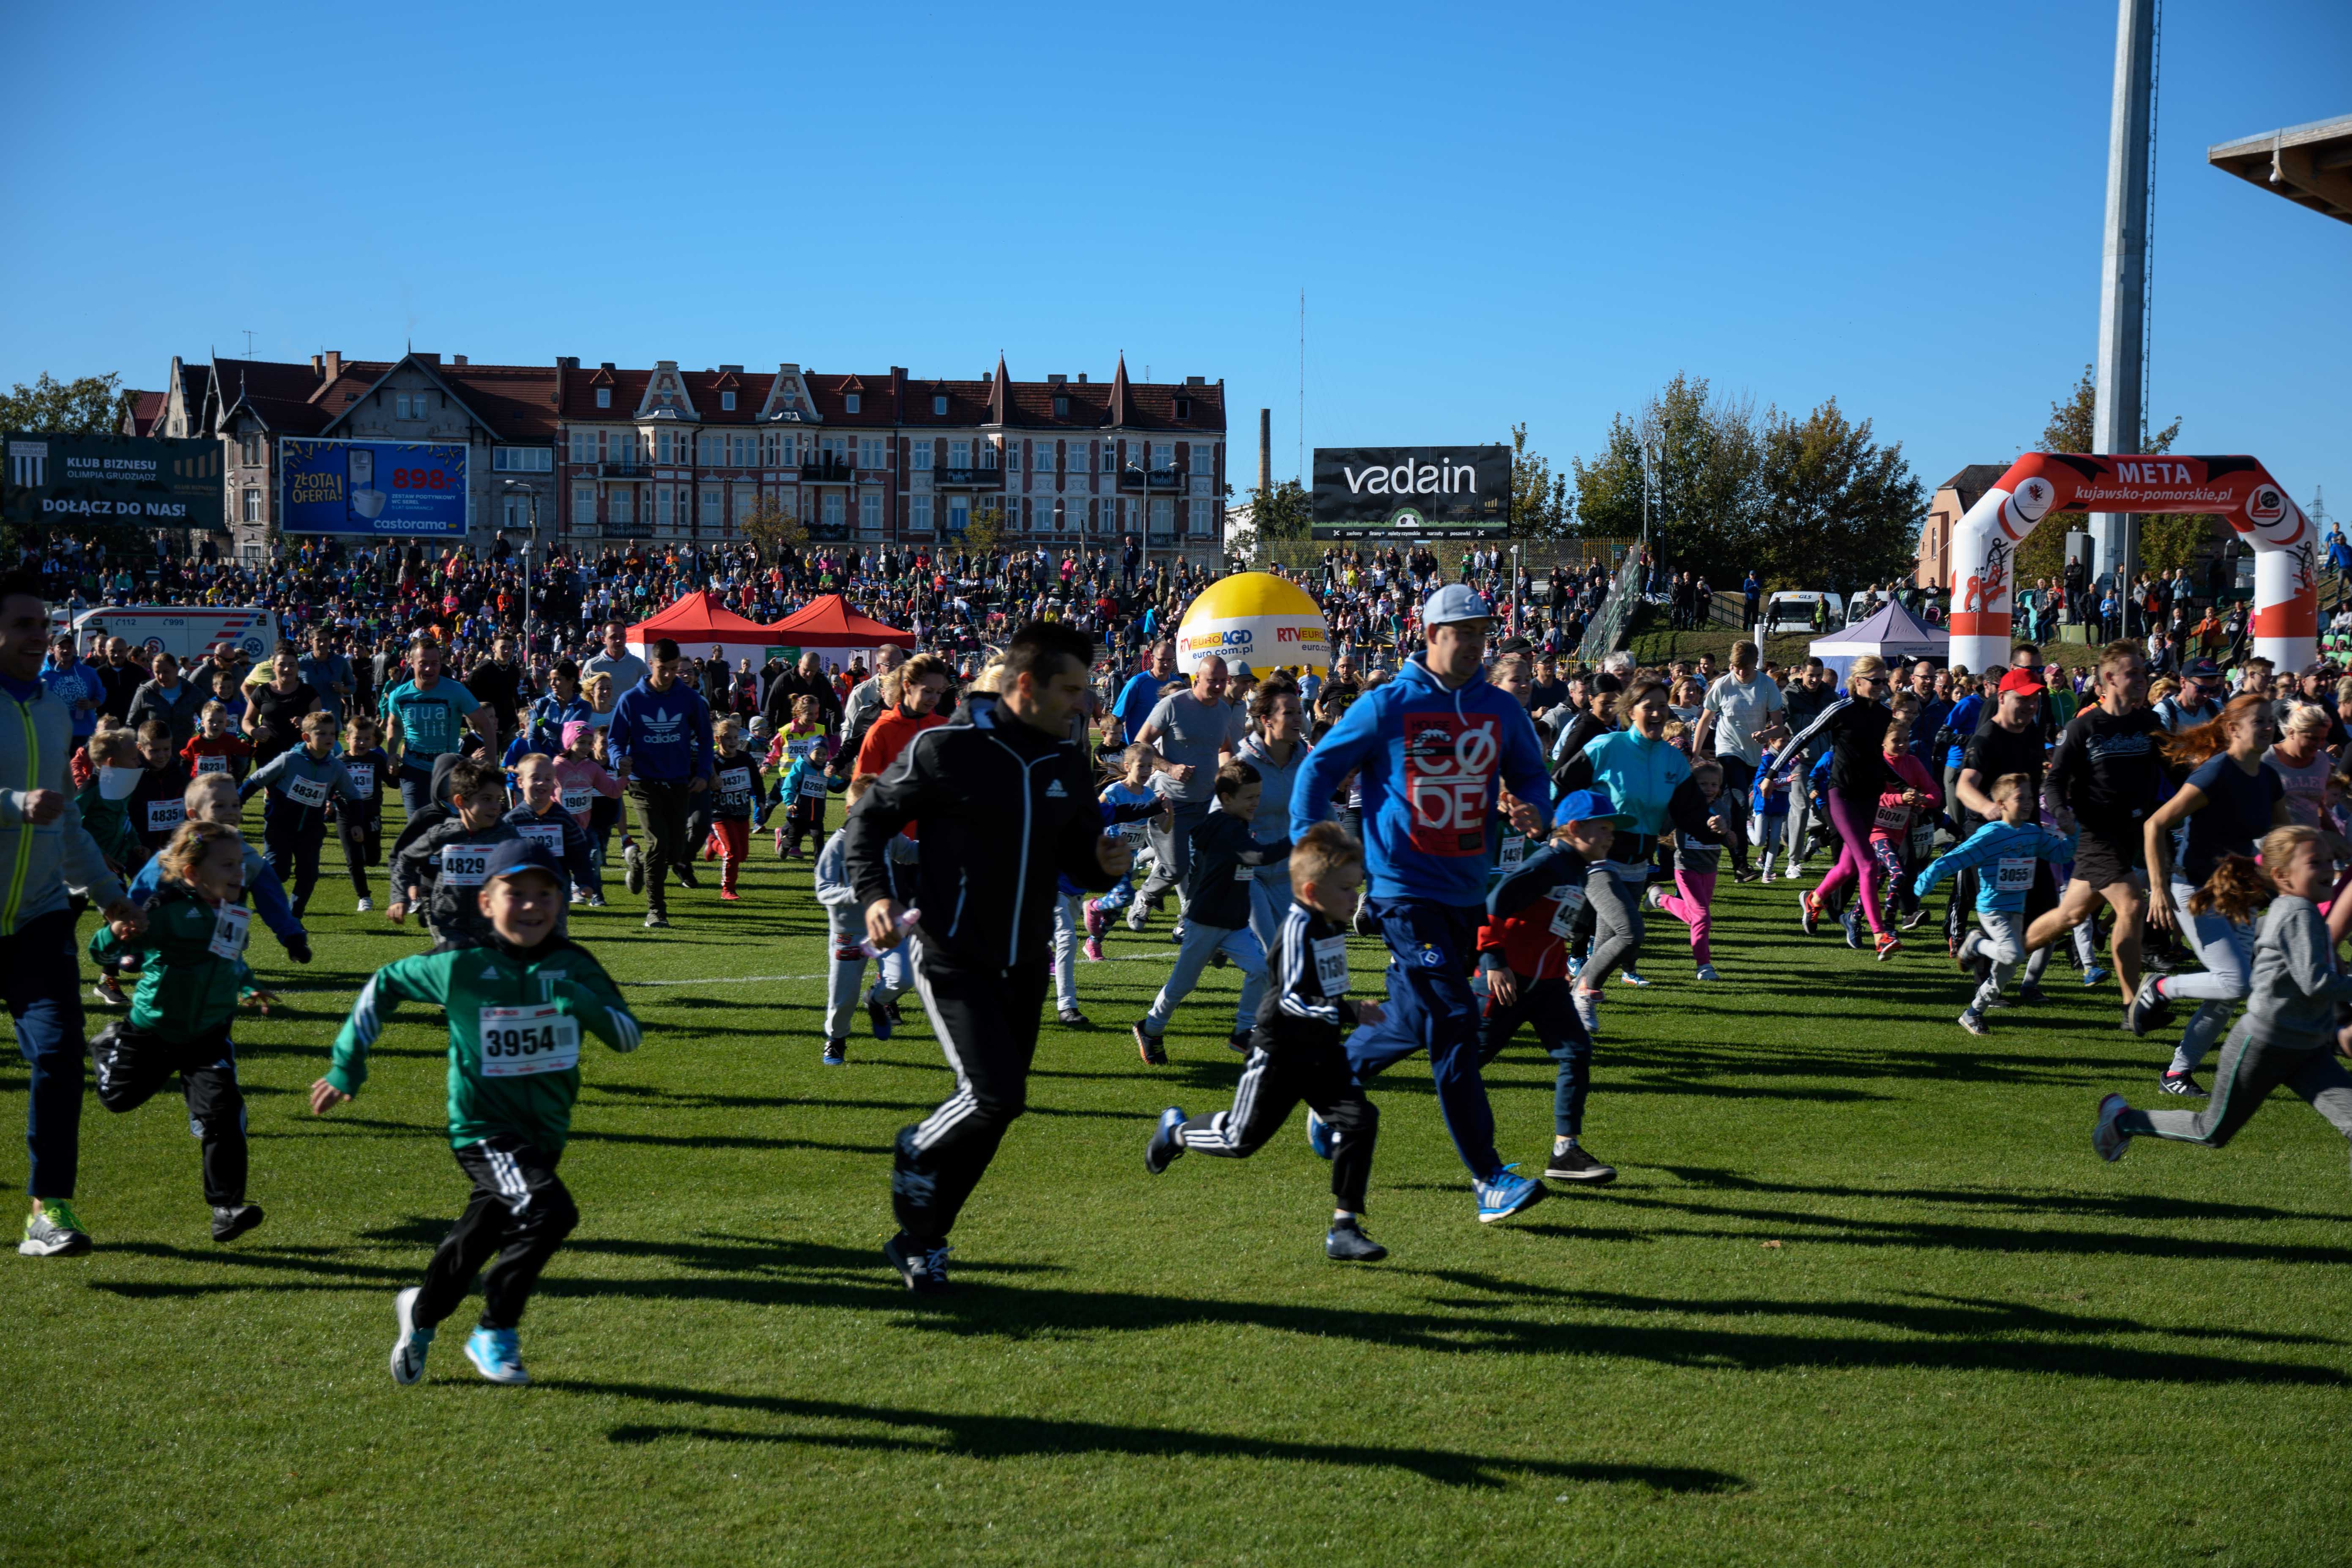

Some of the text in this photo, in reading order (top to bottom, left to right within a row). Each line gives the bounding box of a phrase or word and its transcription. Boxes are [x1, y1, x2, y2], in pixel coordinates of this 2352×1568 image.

[67, 457, 156, 470] KLUB BIZNESU
[106, 471, 156, 482] GRUDZIĄDZ
[293, 471, 335, 488] ZŁOTA
[1343, 457, 1477, 494] vadain
[2117, 462, 2192, 484] META
[2074, 486, 2232, 503] kujawsko-pomorskie.pl
[43, 498, 185, 517] DOŁĄCZ DO NAS!
[374, 518, 446, 531] castorama
[1412, 720, 1451, 731] HOUSE
[643, 733, 681, 744] adidas
[789, 746, 808, 755] 2059
[199, 763, 220, 772] 4823
[722, 775, 741, 786] 1437
[804, 781, 823, 792] 6266
[293, 783, 319, 799] 4834
[565, 796, 586, 807] 1903
[151, 808, 178, 822] 4835
[1878, 809, 1901, 822] 6074
[446, 858, 484, 874] 4829
[2000, 868, 2028, 881] 3055
[487, 1025, 553, 1057] 3954
